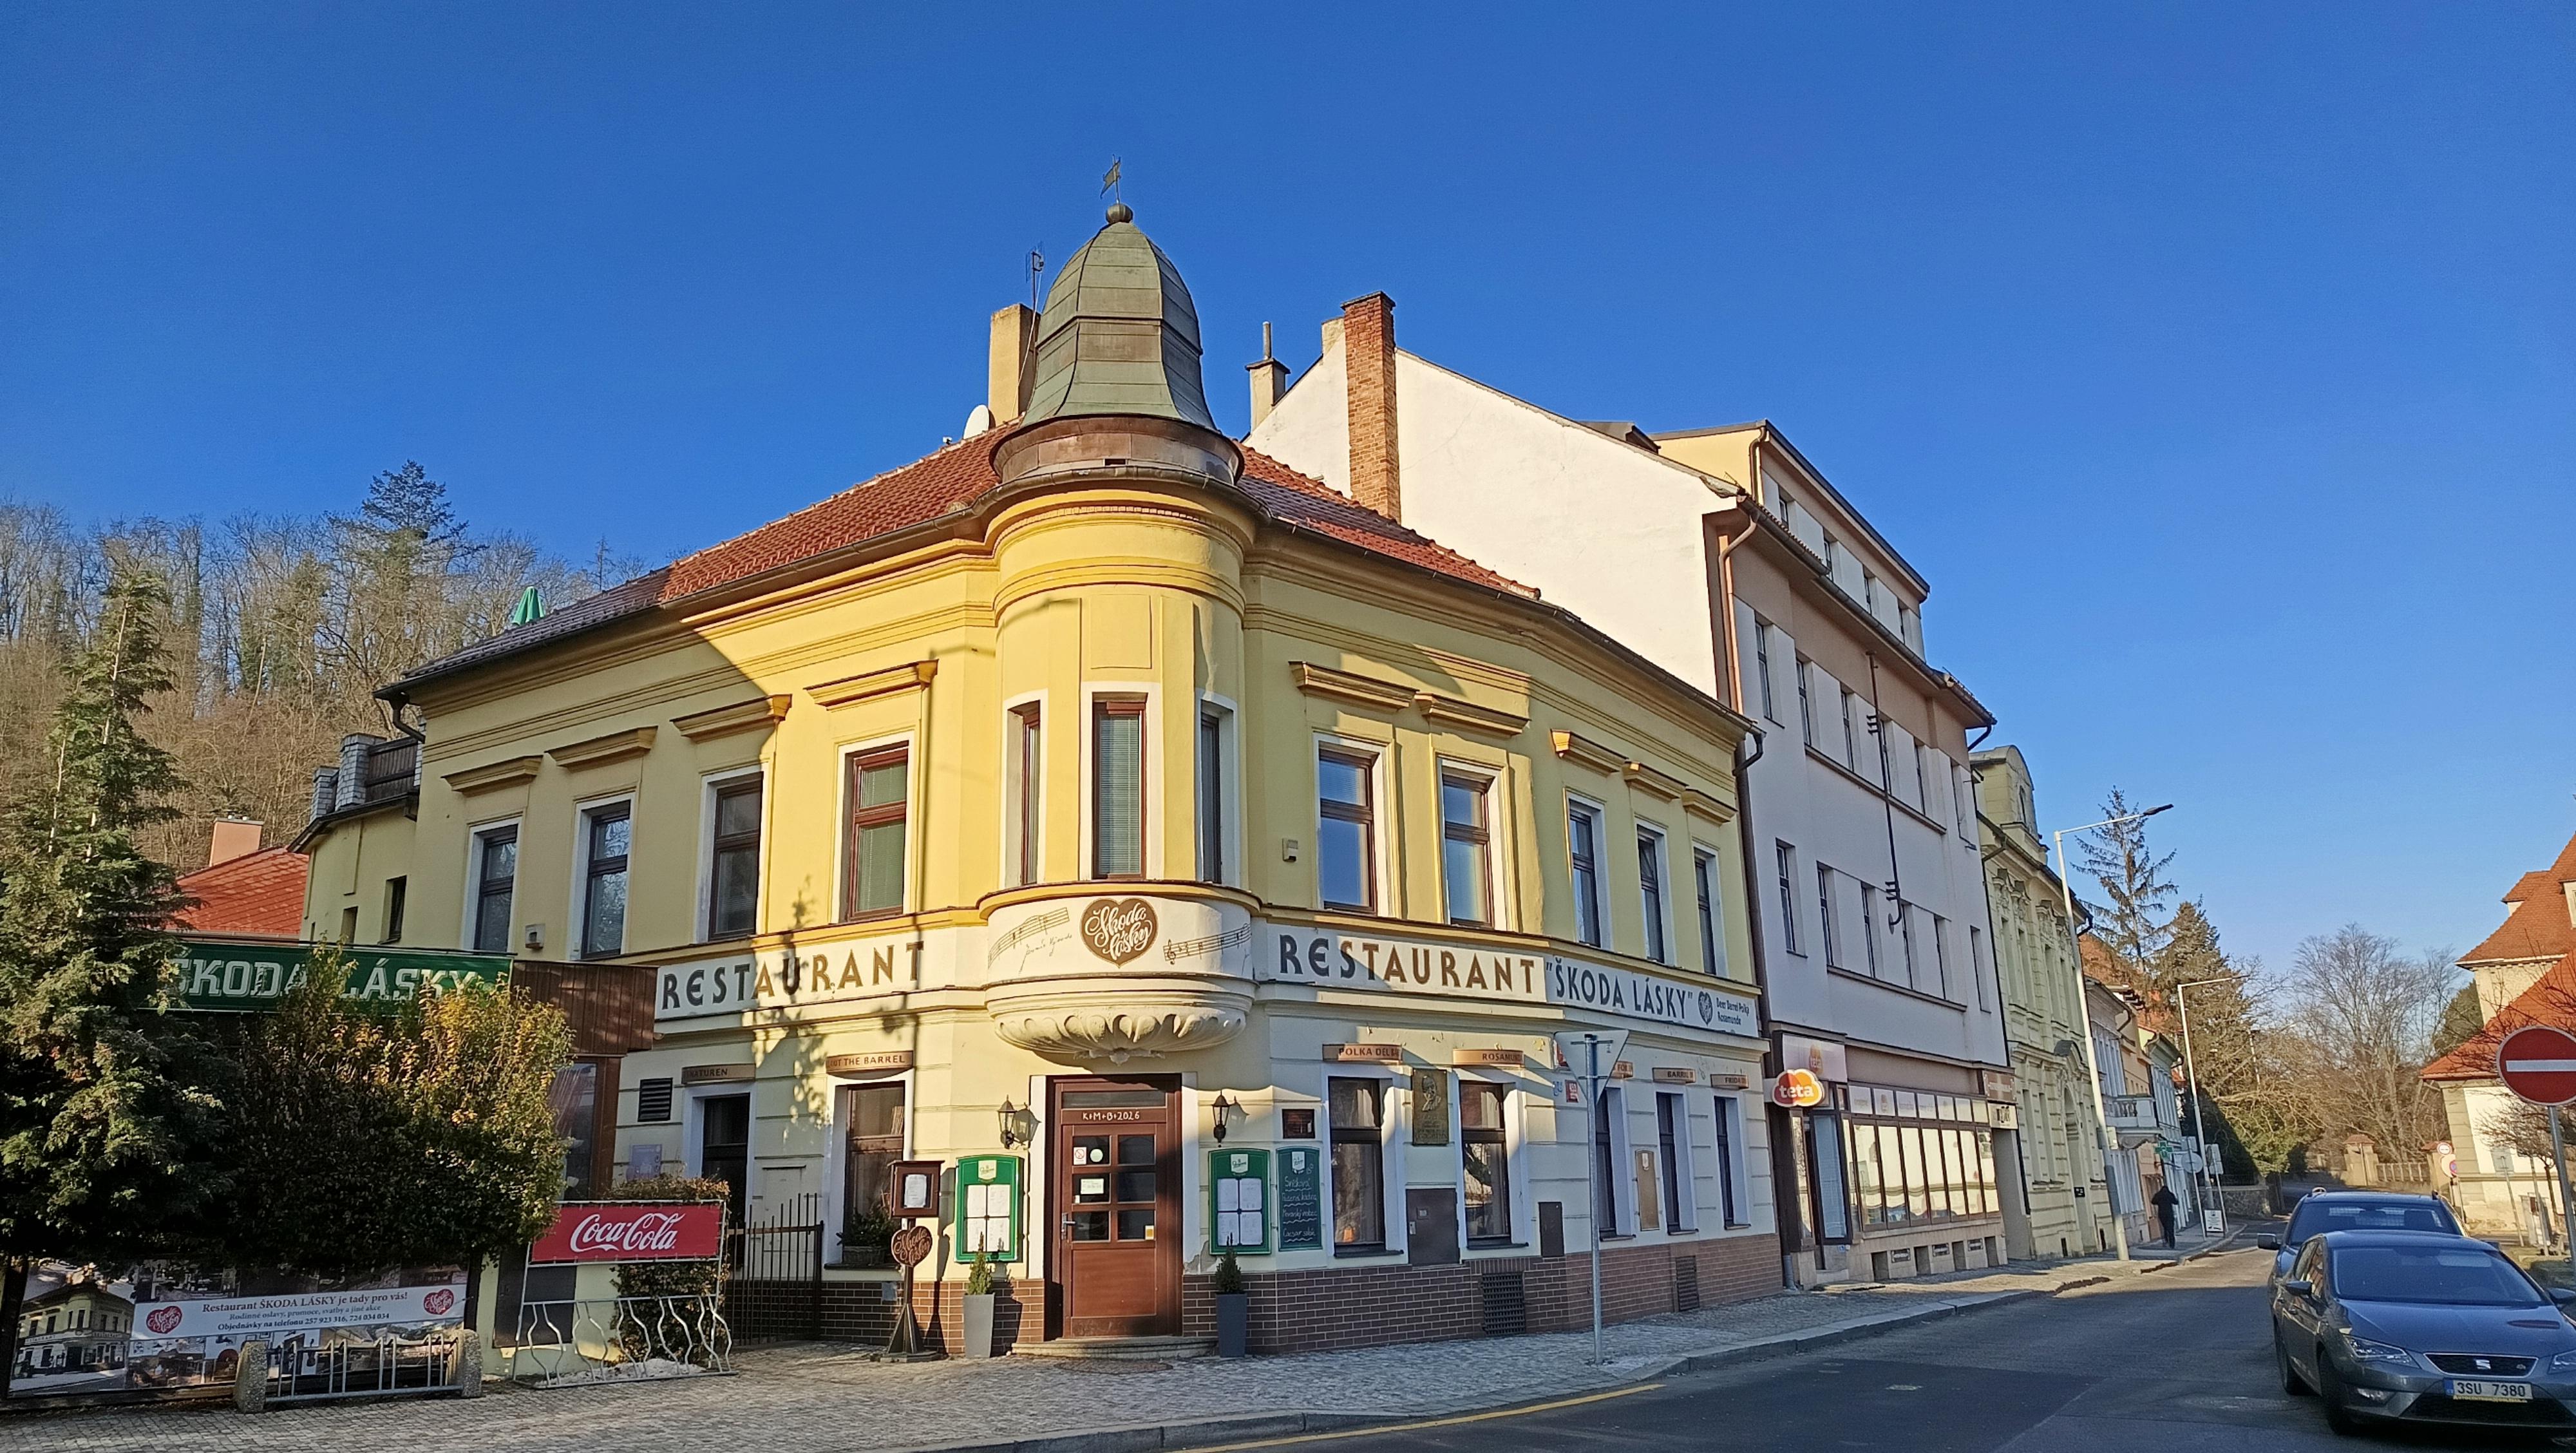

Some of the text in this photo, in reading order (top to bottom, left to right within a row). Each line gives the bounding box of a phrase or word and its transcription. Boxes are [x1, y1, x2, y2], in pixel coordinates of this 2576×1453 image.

[1085, 902, 1146, 947] Škoda
[1103, 920, 1152, 960] lásky
[1280, 934, 1534, 994] RESTAURANT
[662, 941, 923, 1010] RESTAURANT
[844, 1058, 860, 1066] THE
[864, 1055, 905, 1065] BARREL
[1779, 1085, 1814, 1098] teta
[570, 1213, 686, 1252] Coca-Cola
[202, 1292, 408, 1313] Restaurant ŠKODA LÁSKY je tady pro vás!
[262, 1310, 286, 1318] oslavy,
[287, 1309, 321, 1318] promoce,
[218, 1322, 262, 1331] Objednávky
[274, 1318, 303, 1327] telefonu
[2458, 1383, 2525, 1397] 3SU 7380
